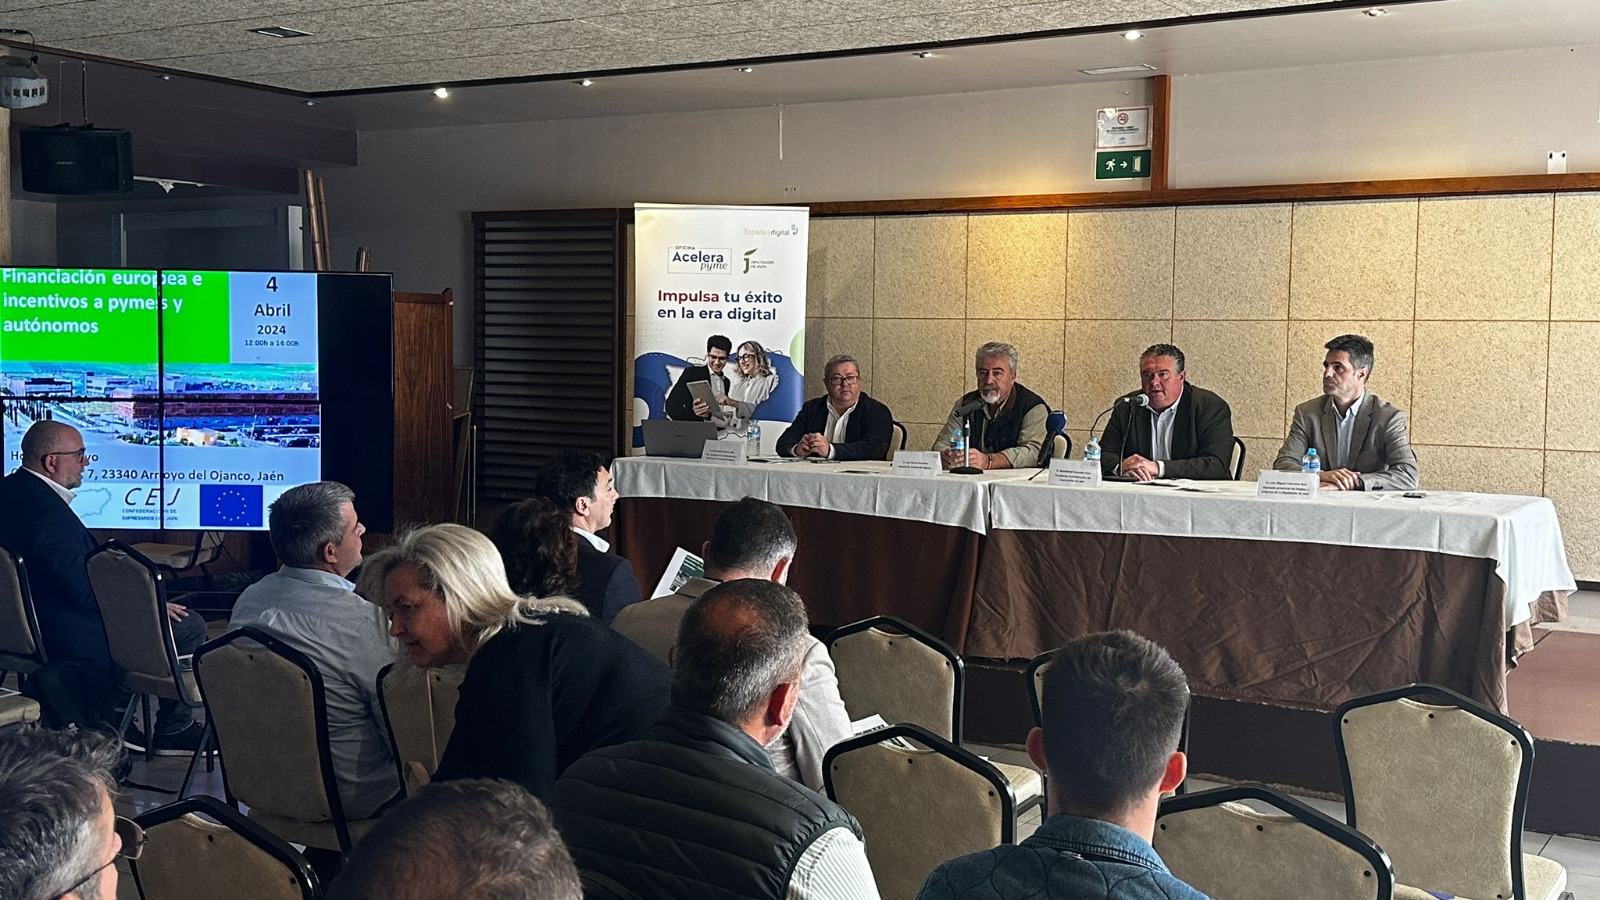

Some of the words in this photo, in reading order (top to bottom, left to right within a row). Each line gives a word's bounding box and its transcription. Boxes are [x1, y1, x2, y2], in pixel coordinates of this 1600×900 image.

[770, 229, 790, 237] digital
[672, 250, 724, 263] Acelera
[699, 262, 728, 271] pyme
[2, 268, 106, 285] Financiación
[112, 273, 187, 289] europea
[192, 274, 203, 286] e
[266, 276, 279, 293] 4
[3, 292, 88, 309] incentivos
[93, 298, 103, 309] a
[108, 297, 168, 313] pymes
[173, 299, 183, 313] y
[658, 290, 720, 304] Impulsa
[724, 291, 740, 303] tu
[745, 291, 783, 304] éxito
[254, 303, 291, 317] Abril
[657, 308, 677, 319] en
[681, 307, 695, 319] la
[698, 309, 723, 320] era
[727, 308, 776, 322] digital
[3, 317, 99, 334] autónomos
[257, 325, 287, 335] 2024
[87, 469, 98, 480] 7,
[101, 469, 138, 480] 23340
[140, 469, 185, 482] Arroyo
[188, 470, 207, 481] del
[210, 470, 255, 483] Ojanco,
[257, 471, 284, 483] Jaén
